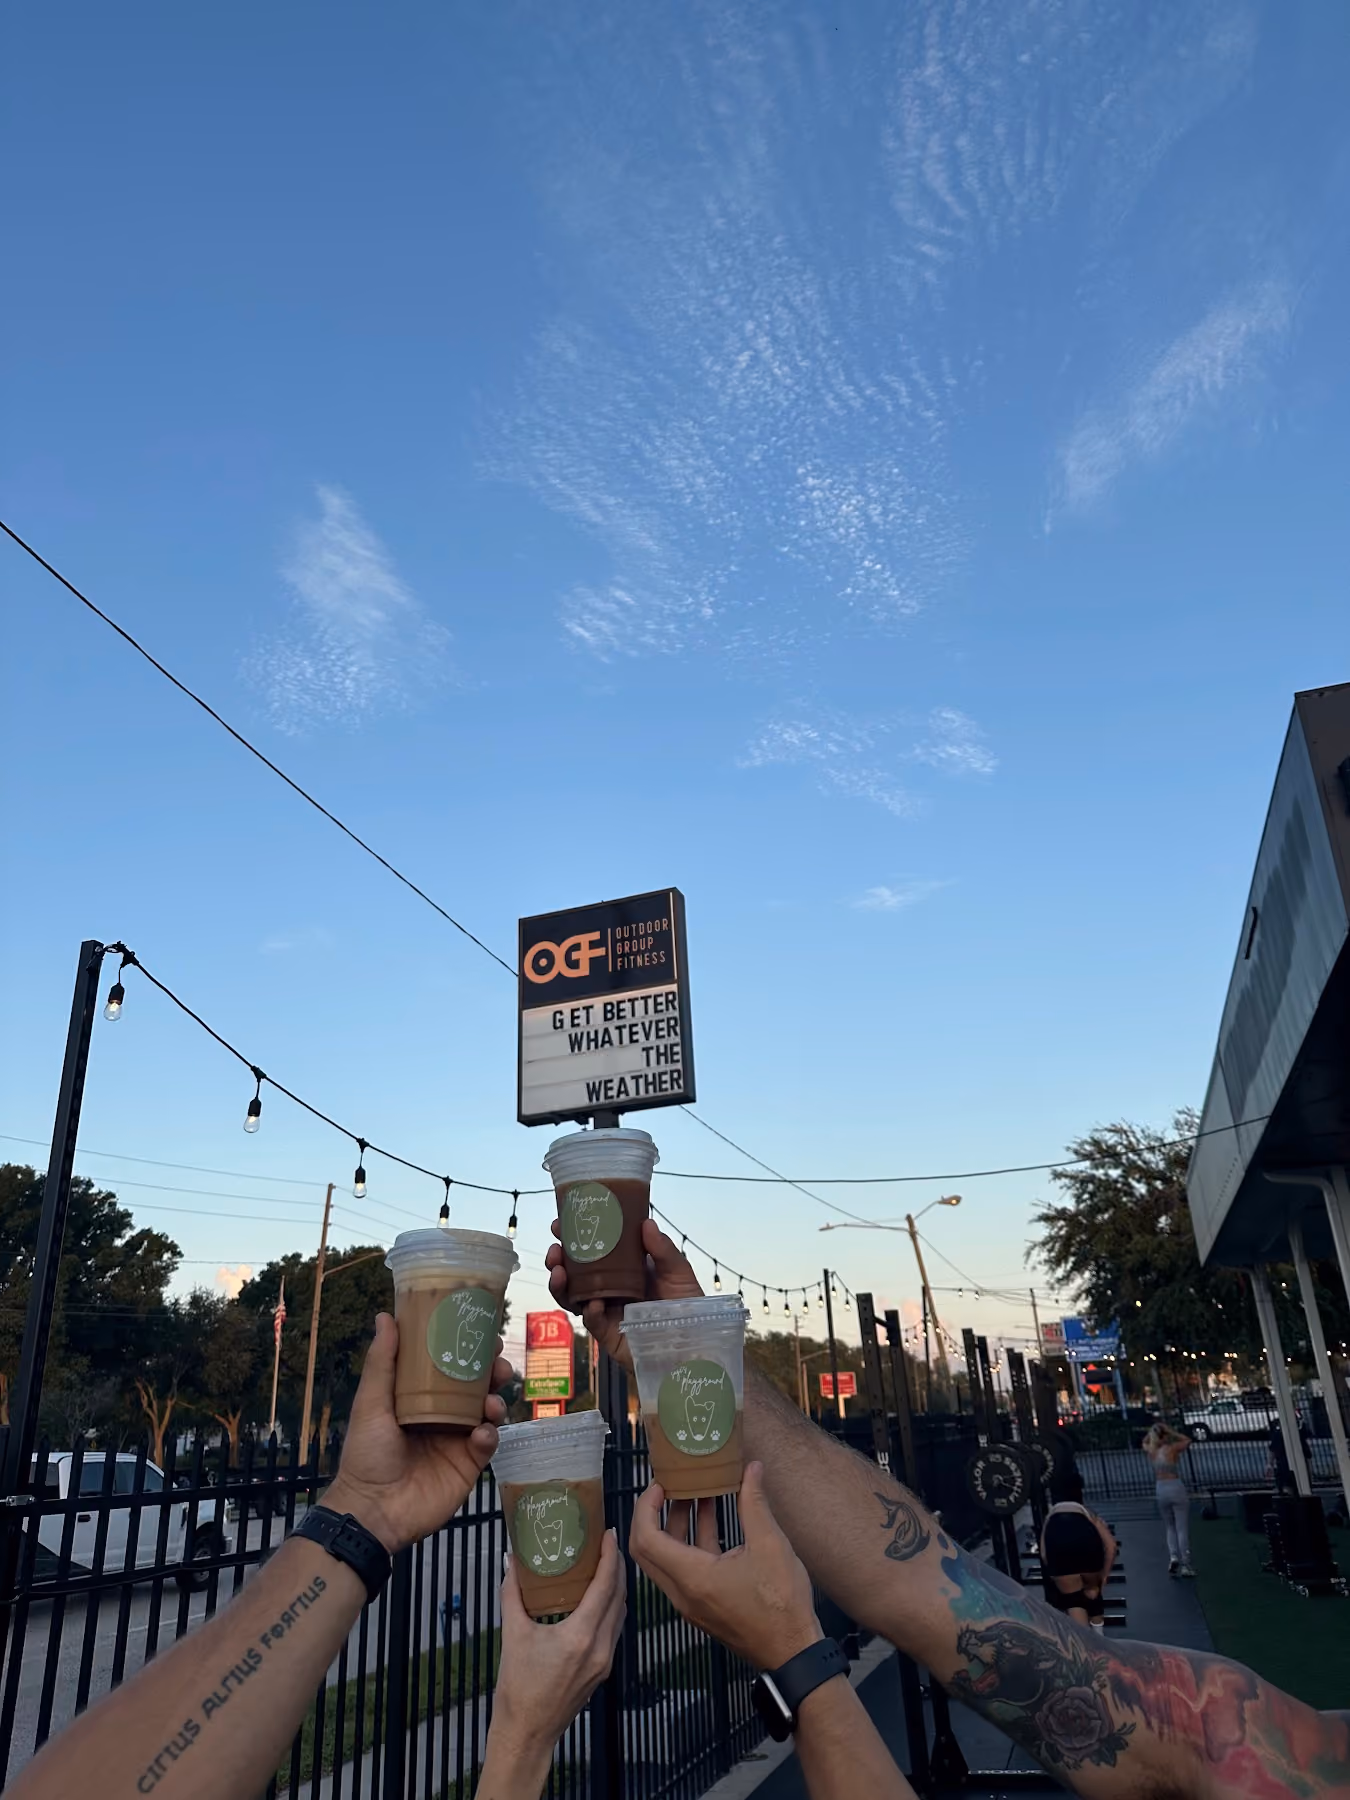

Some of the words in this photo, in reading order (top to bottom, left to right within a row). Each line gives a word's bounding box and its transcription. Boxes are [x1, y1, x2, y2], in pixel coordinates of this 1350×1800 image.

[615, 918, 669, 939] OUTDOOR
[523, 930, 606, 984] OGF
[616, 937, 654, 955] GROUP
[616, 951, 666, 971] FITNESS
[552, 1004, 594, 1030] GET
[603, 991, 677, 1022] BETTER
[568, 1017, 680, 1053] WHATEVER
[642, 1043, 681, 1068] THE
[586, 1069, 682, 1104] WEATHER
